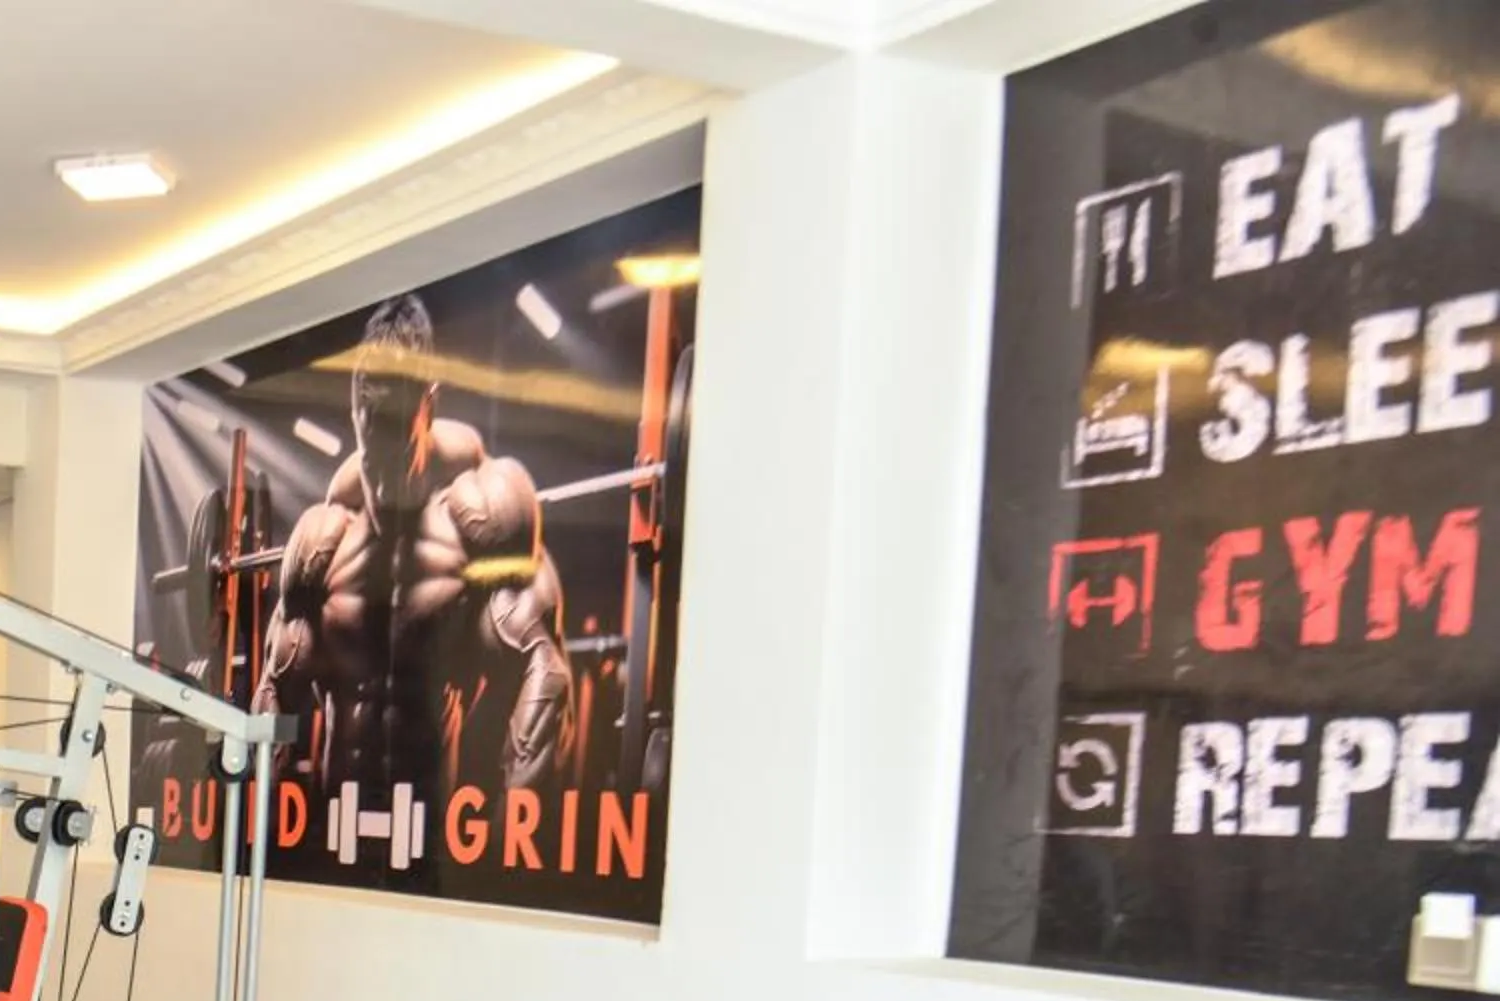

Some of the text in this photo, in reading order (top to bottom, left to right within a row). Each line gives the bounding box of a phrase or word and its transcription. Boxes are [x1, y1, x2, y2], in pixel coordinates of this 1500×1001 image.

[1212, 92, 1461, 280] EAT
[1199, 289, 1500, 463] SLEE
[1195, 507, 1481, 653] GYM
[161, 776, 649, 879] BUD GRIN
